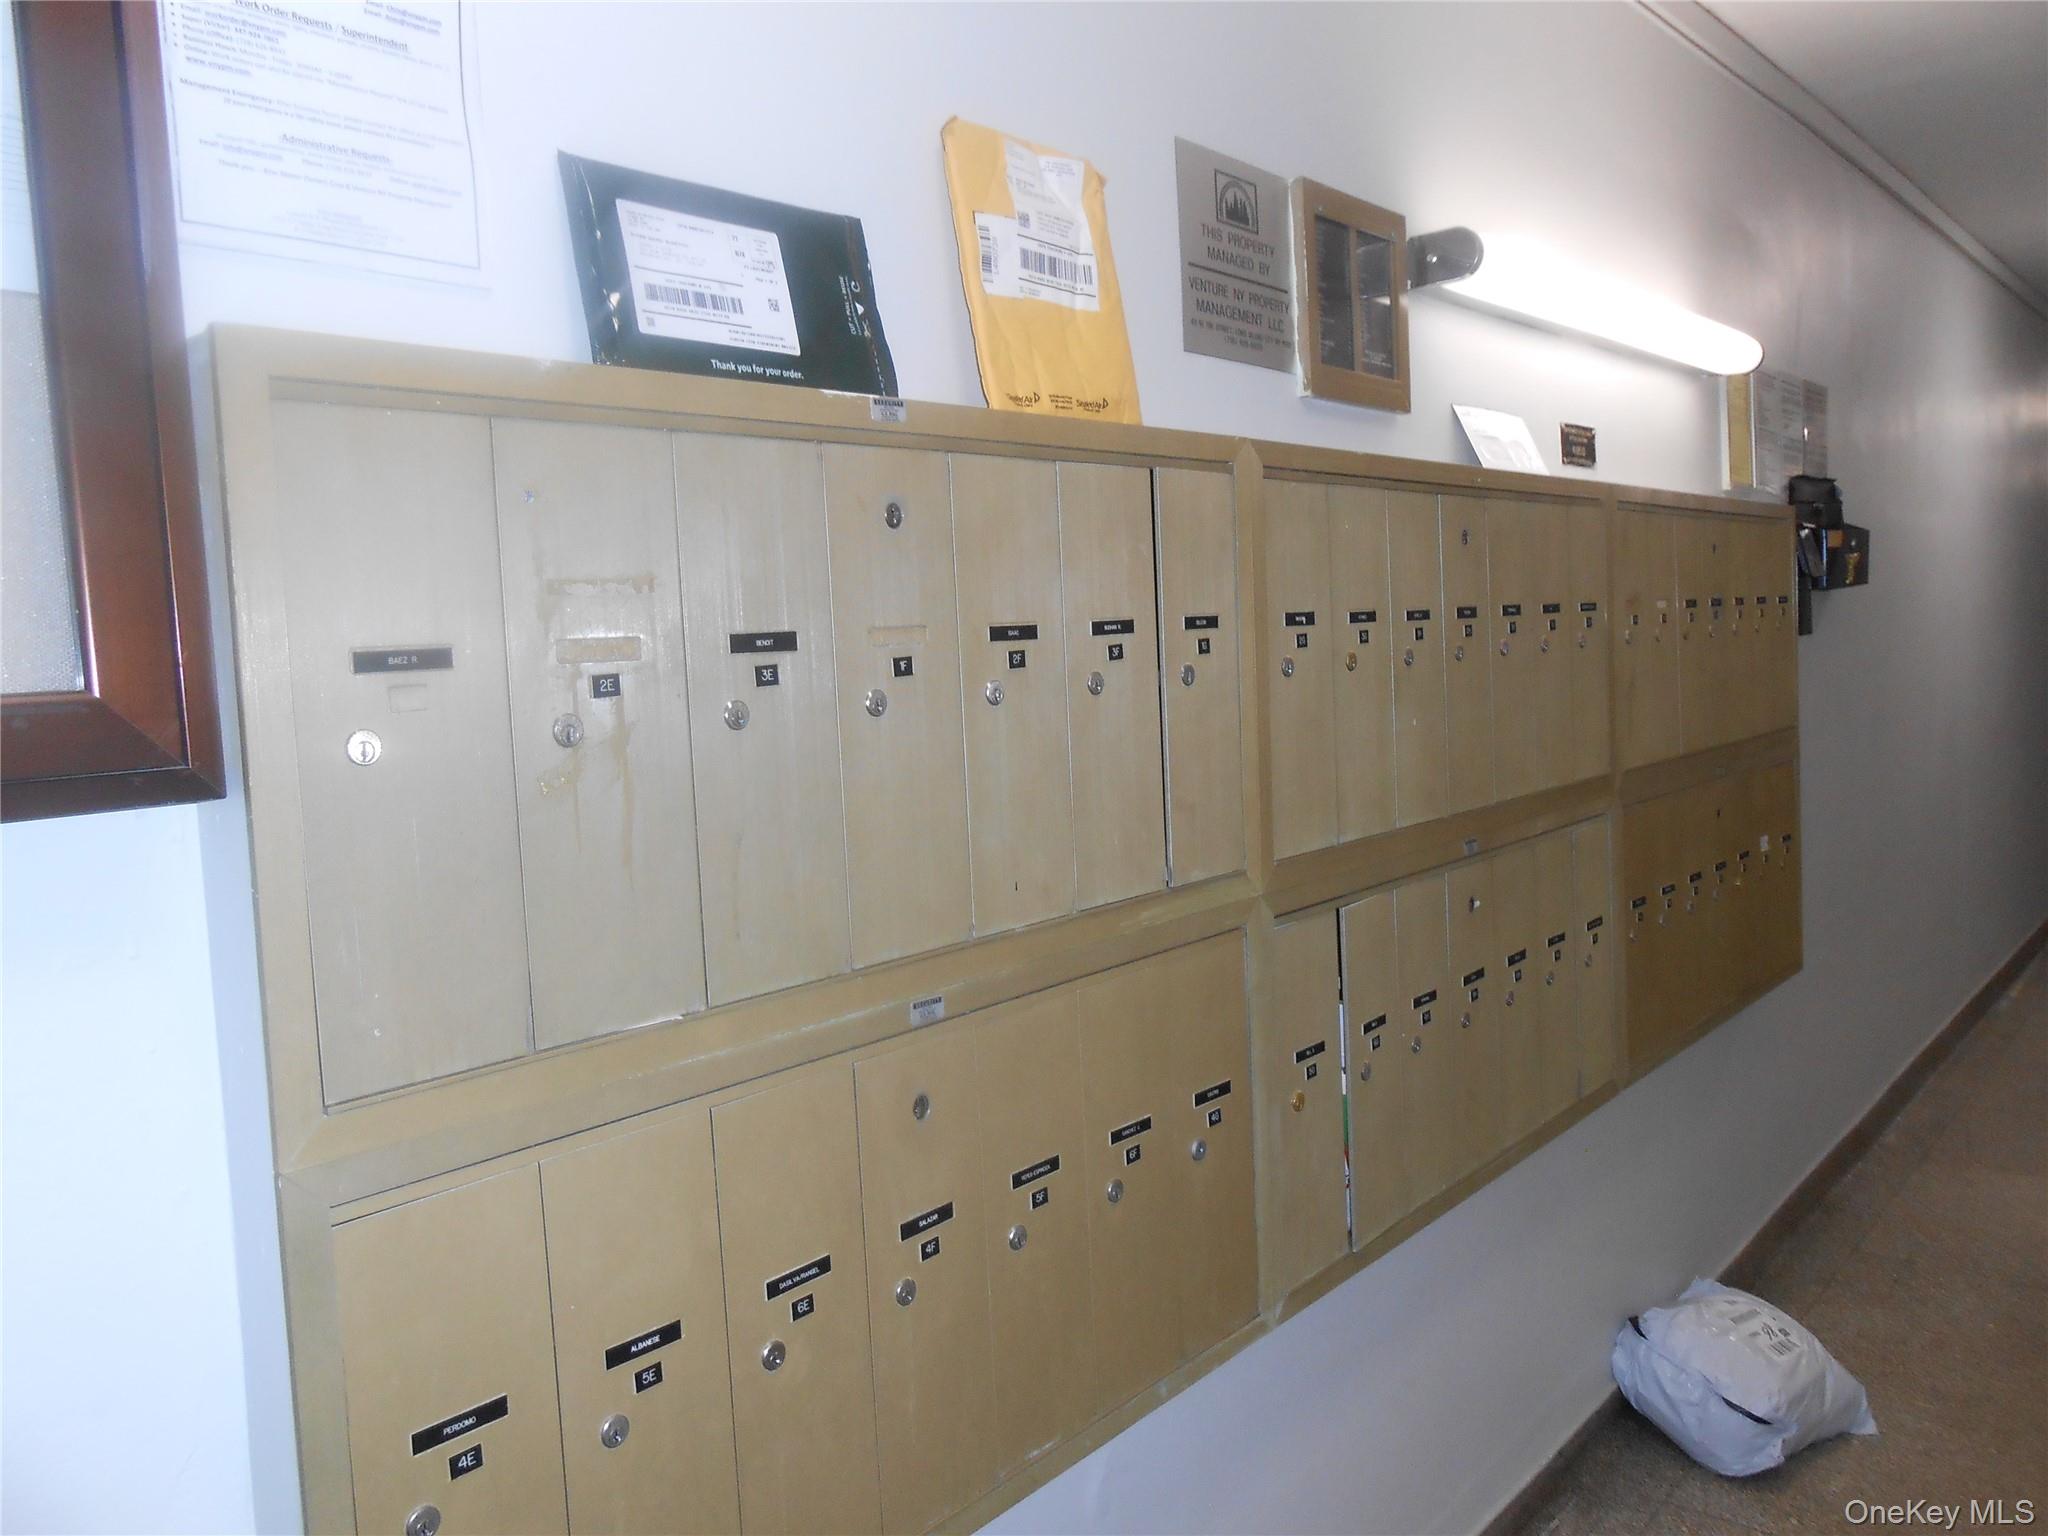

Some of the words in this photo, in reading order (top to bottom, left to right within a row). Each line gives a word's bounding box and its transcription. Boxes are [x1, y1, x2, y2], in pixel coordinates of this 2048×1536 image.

[261, 2, 289, 17] Order
[291, 10, 333, 31] Requests
[340, 24, 409, 53] Superintendent
[281, 133, 349, 155] Administrative
[351, 148, 391, 165] Requests
[1200, 223, 1223, 242] THIS
[1227, 231, 1276, 259] PROPERTY
[1207, 245, 1255, 271] MANAGED
[1258, 263, 1271, 276] BY
[1188, 276, 1229, 299] VENTURE
[1233, 287, 1245, 302] NY
[1248, 291, 1290, 315] PROPERTY
[1196, 298, 1264, 329] MANAGEMENT
[1267, 316, 1285, 334] LLC
[710, 359, 737, 371] Thank
[737, 363, 752, 374] you
[752, 364, 764, 373] for
[765, 367, 781, 377] your
[782, 369, 804, 380] order.
[388, 655, 409, 665] BAEZ
[411, 655, 418, 665] R
[1012, 652, 1022, 665] 2F
[1111, 647, 1120, 657] 3F
[899, 660, 908, 672] 1F
[761, 668, 774, 682] 3E
[599, 678, 615, 692] 2E
[1129, 1147, 1138, 1159] 6F
[1036, 1190, 1045, 1203] 5F
[918, 1213, 938, 1227] SALAZAR
[925, 1241, 936, 1255] 4F
[797, 1298, 810, 1314] 6E
[630, 1334, 662, 1353] ALBANESE
[641, 1367, 657, 1385] 5E
[442, 1415, 477, 1436] PERDOMO
[457, 1450, 477, 1469] 4E
